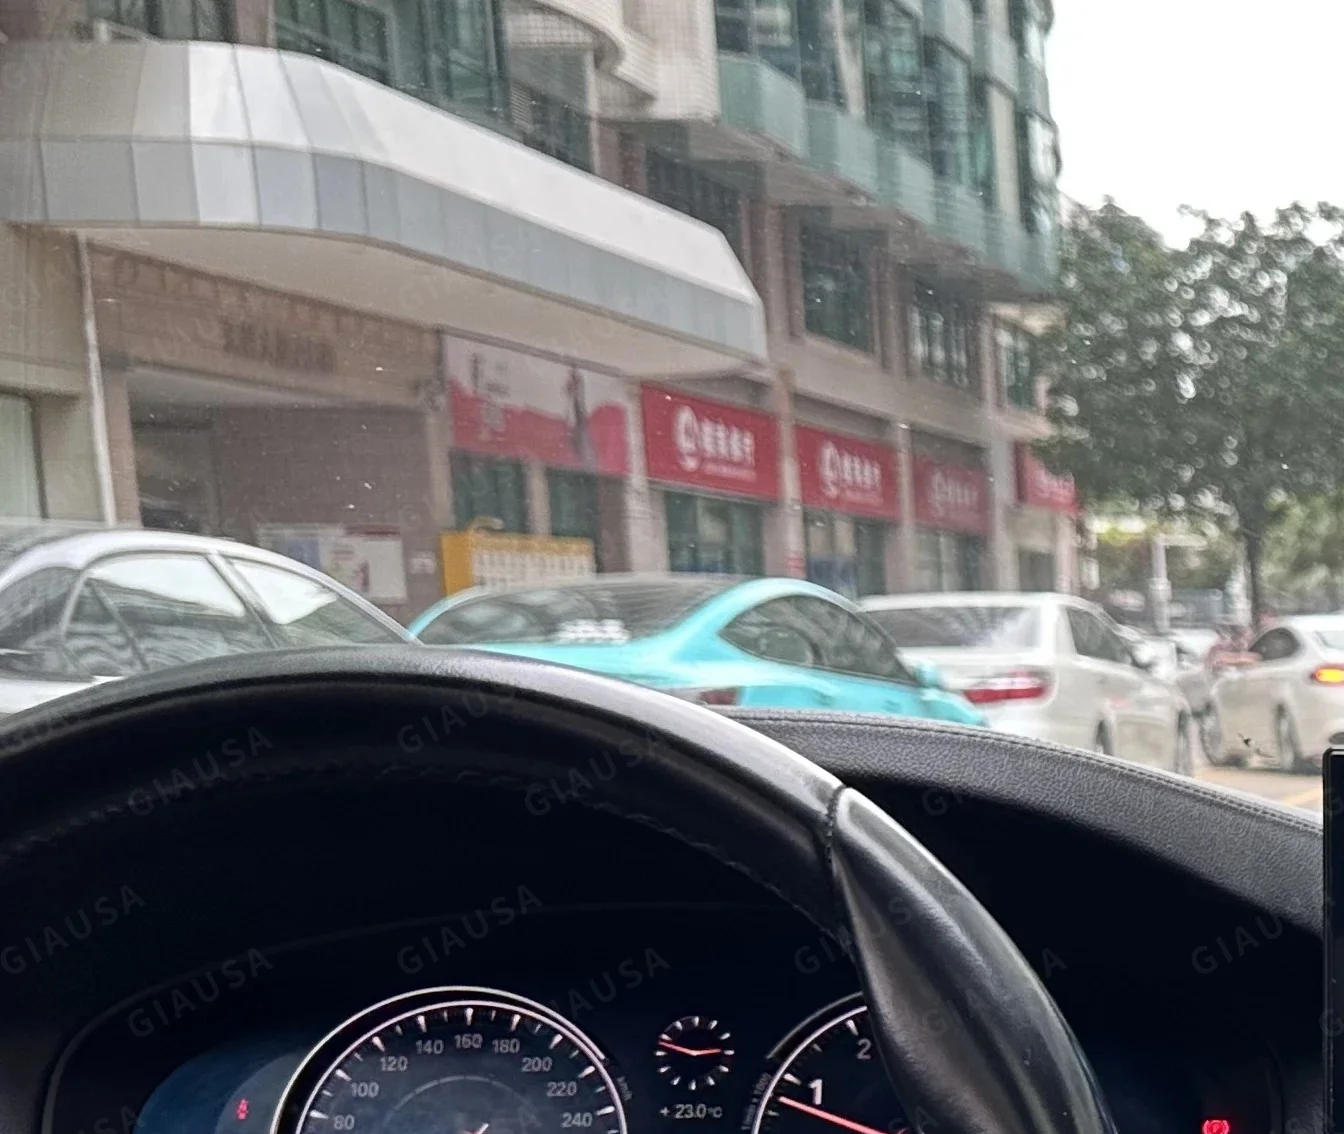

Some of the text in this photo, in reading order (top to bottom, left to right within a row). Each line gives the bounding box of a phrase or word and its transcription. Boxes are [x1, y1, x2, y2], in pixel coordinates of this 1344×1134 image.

[415, 1039, 444, 1054] 140
[455, 1033, 483, 1049] 160
[492, 1038, 520, 1054] 180
[857, 1038, 872, 1060] 2
[379, 1056, 408, 1072] 120
[521, 1056, 552, 1072] 200
[350, 1082, 379, 1097] 100
[546, 1081, 577, 1097] 220
[808, 1078, 823, 1105] 1
[333, 1114, 355, 1130] 80
[561, 1112, 593, 1128] 240
